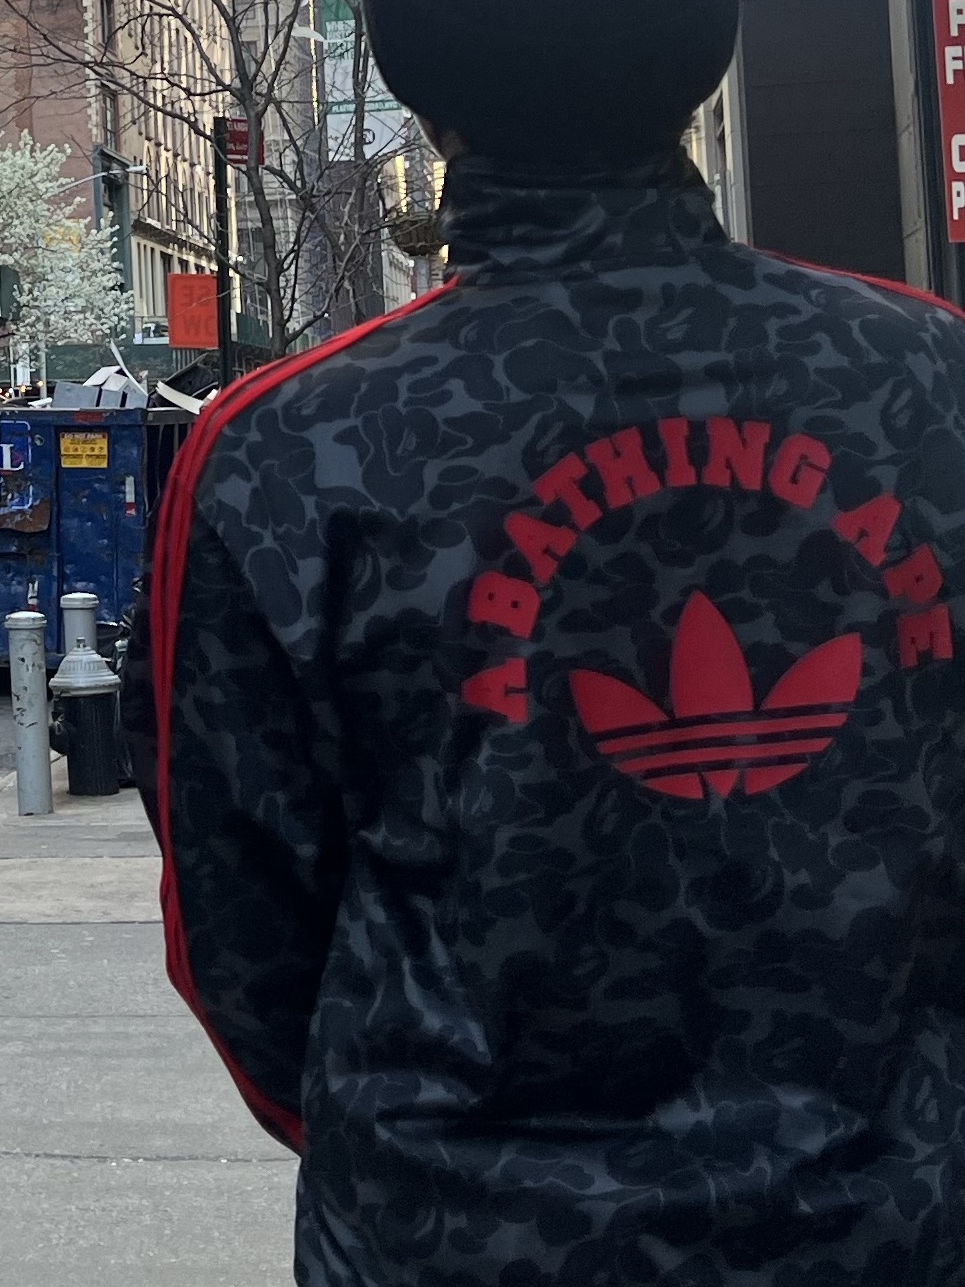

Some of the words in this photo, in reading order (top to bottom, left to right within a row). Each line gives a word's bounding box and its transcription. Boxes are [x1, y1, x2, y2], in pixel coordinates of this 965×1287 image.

[468, 416, 832, 639] BATHING
[832, 492, 954, 669] APE
[461, 657, 528, 724] A
